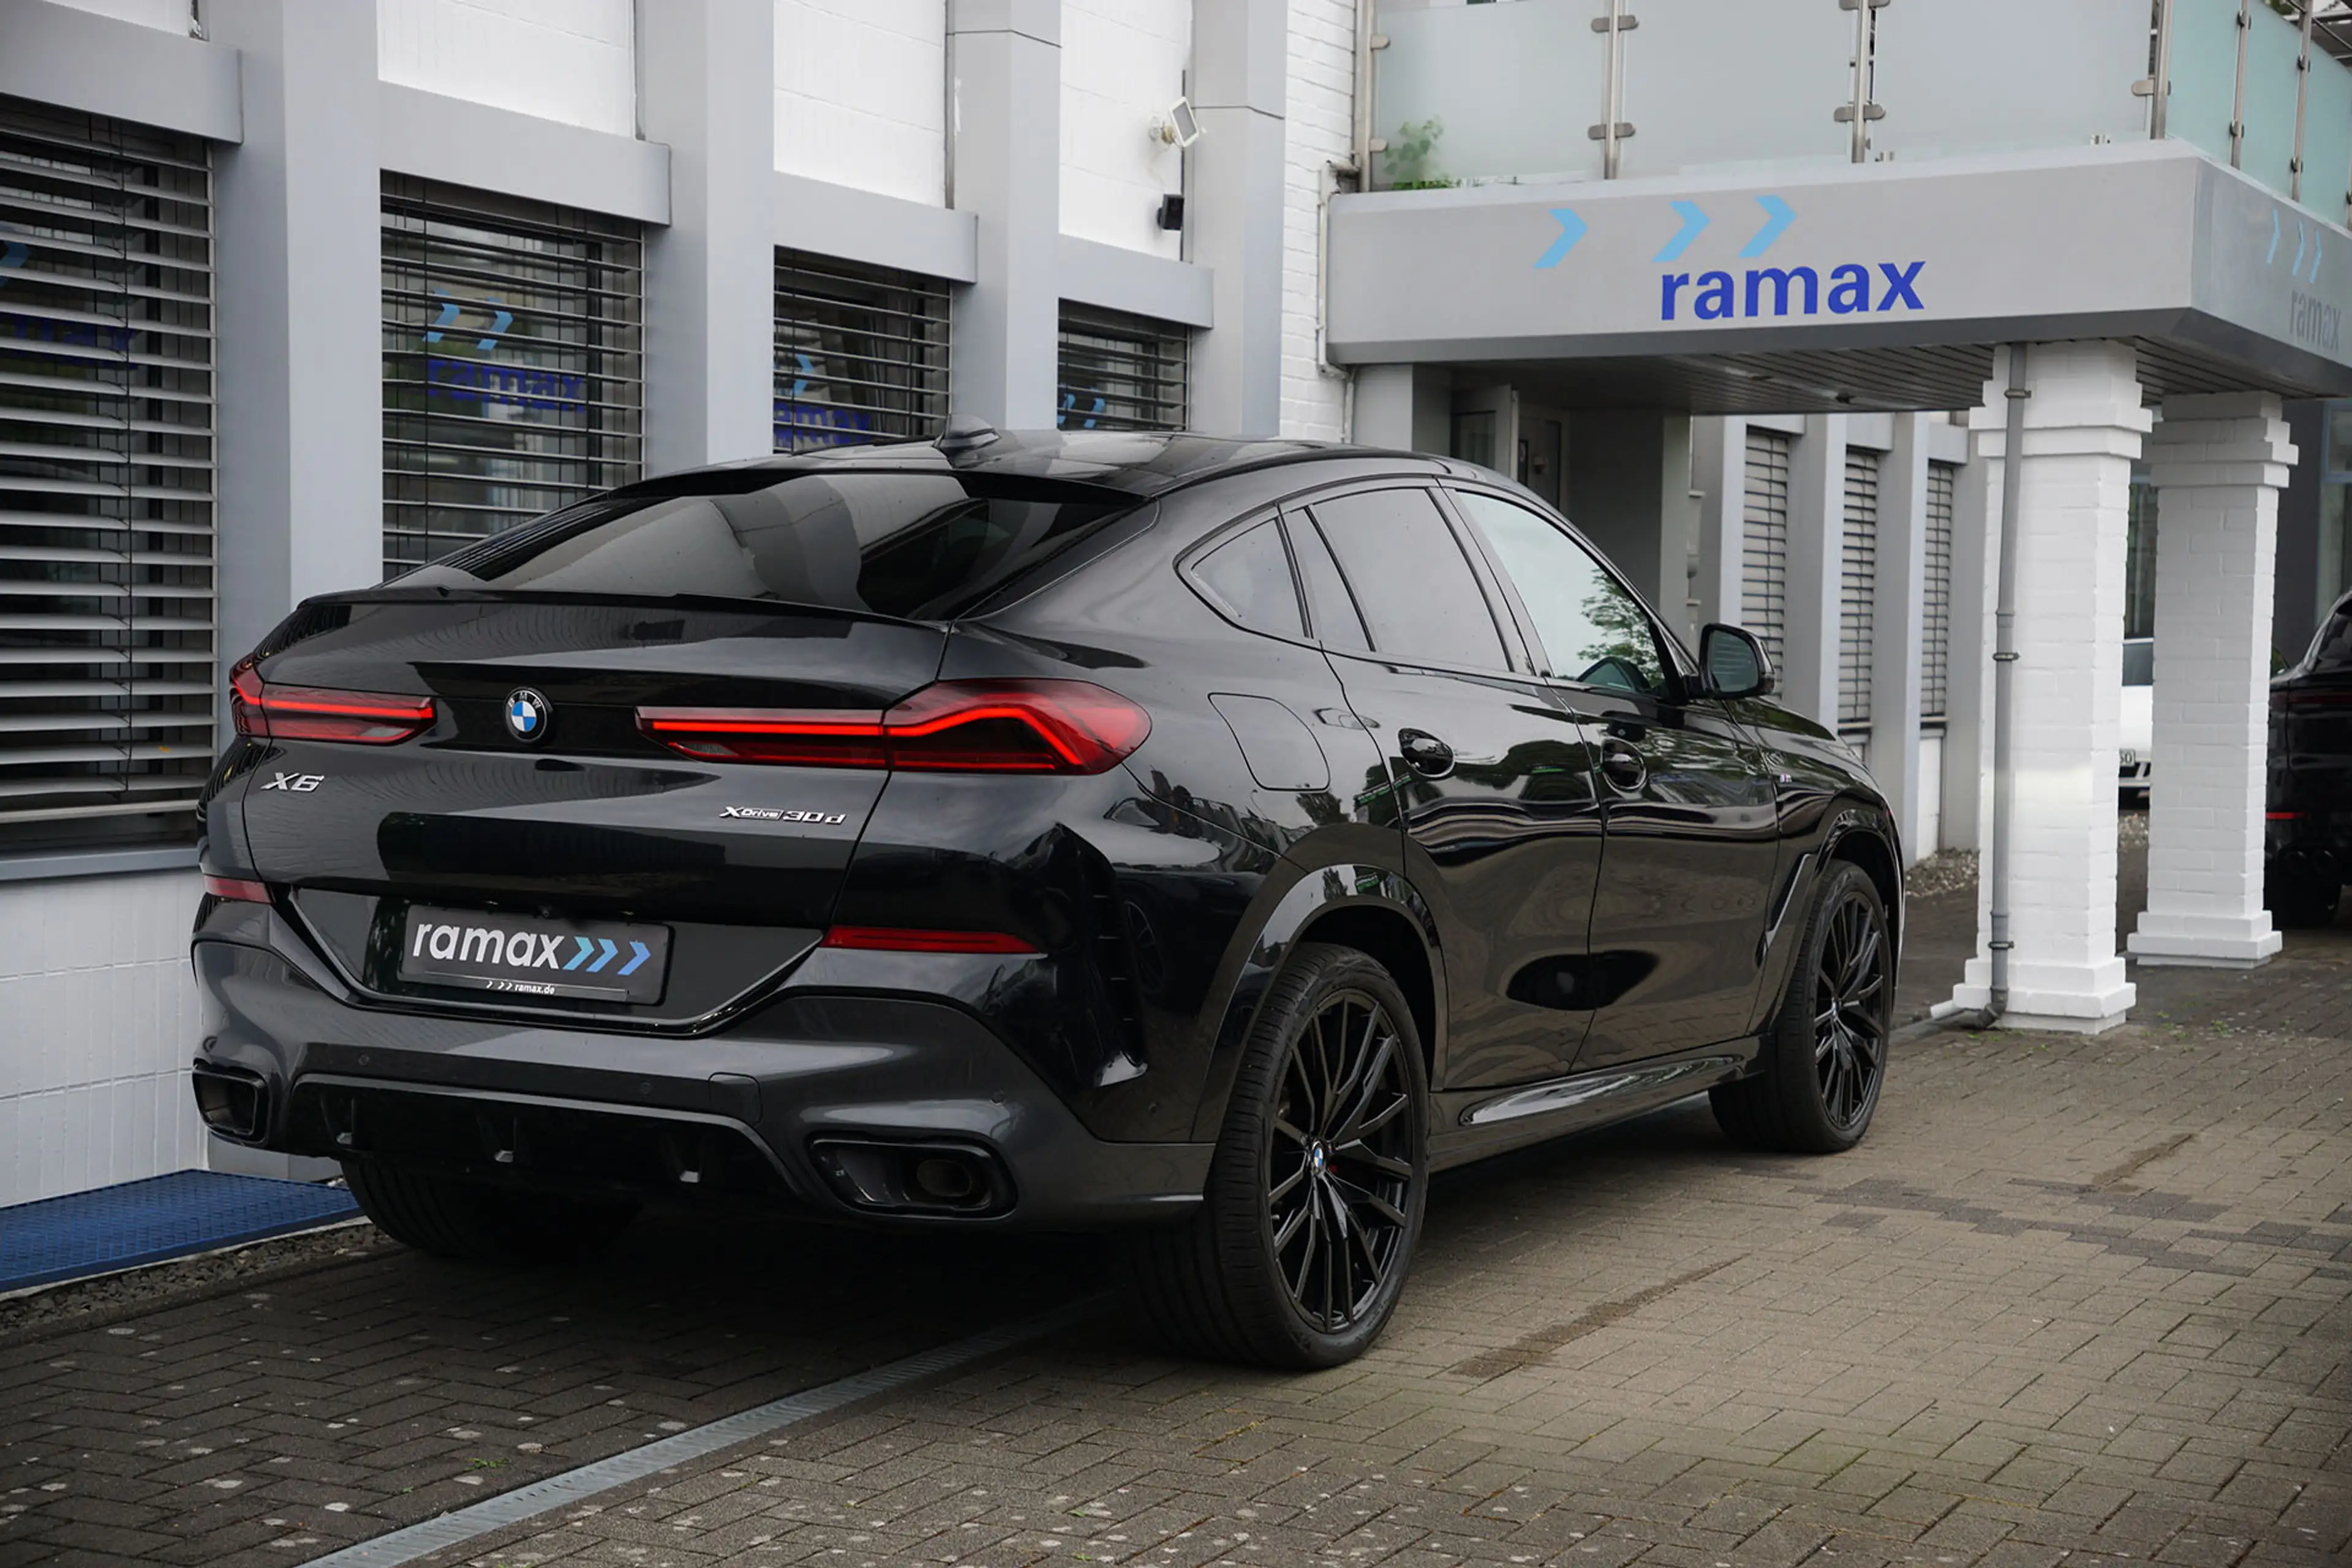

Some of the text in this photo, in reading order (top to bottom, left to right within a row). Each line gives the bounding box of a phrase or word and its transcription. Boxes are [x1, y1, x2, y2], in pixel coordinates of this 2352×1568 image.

[1661, 262, 1924, 321] ramax
[2290, 288, 2342, 353] ramax
[428, 360, 586, 413] ramax
[508, 692, 541, 709] BMW
[261, 772, 325, 792] X6
[412, 923, 565, 970] ramax
[514, 984, 555, 995] ramax.de
